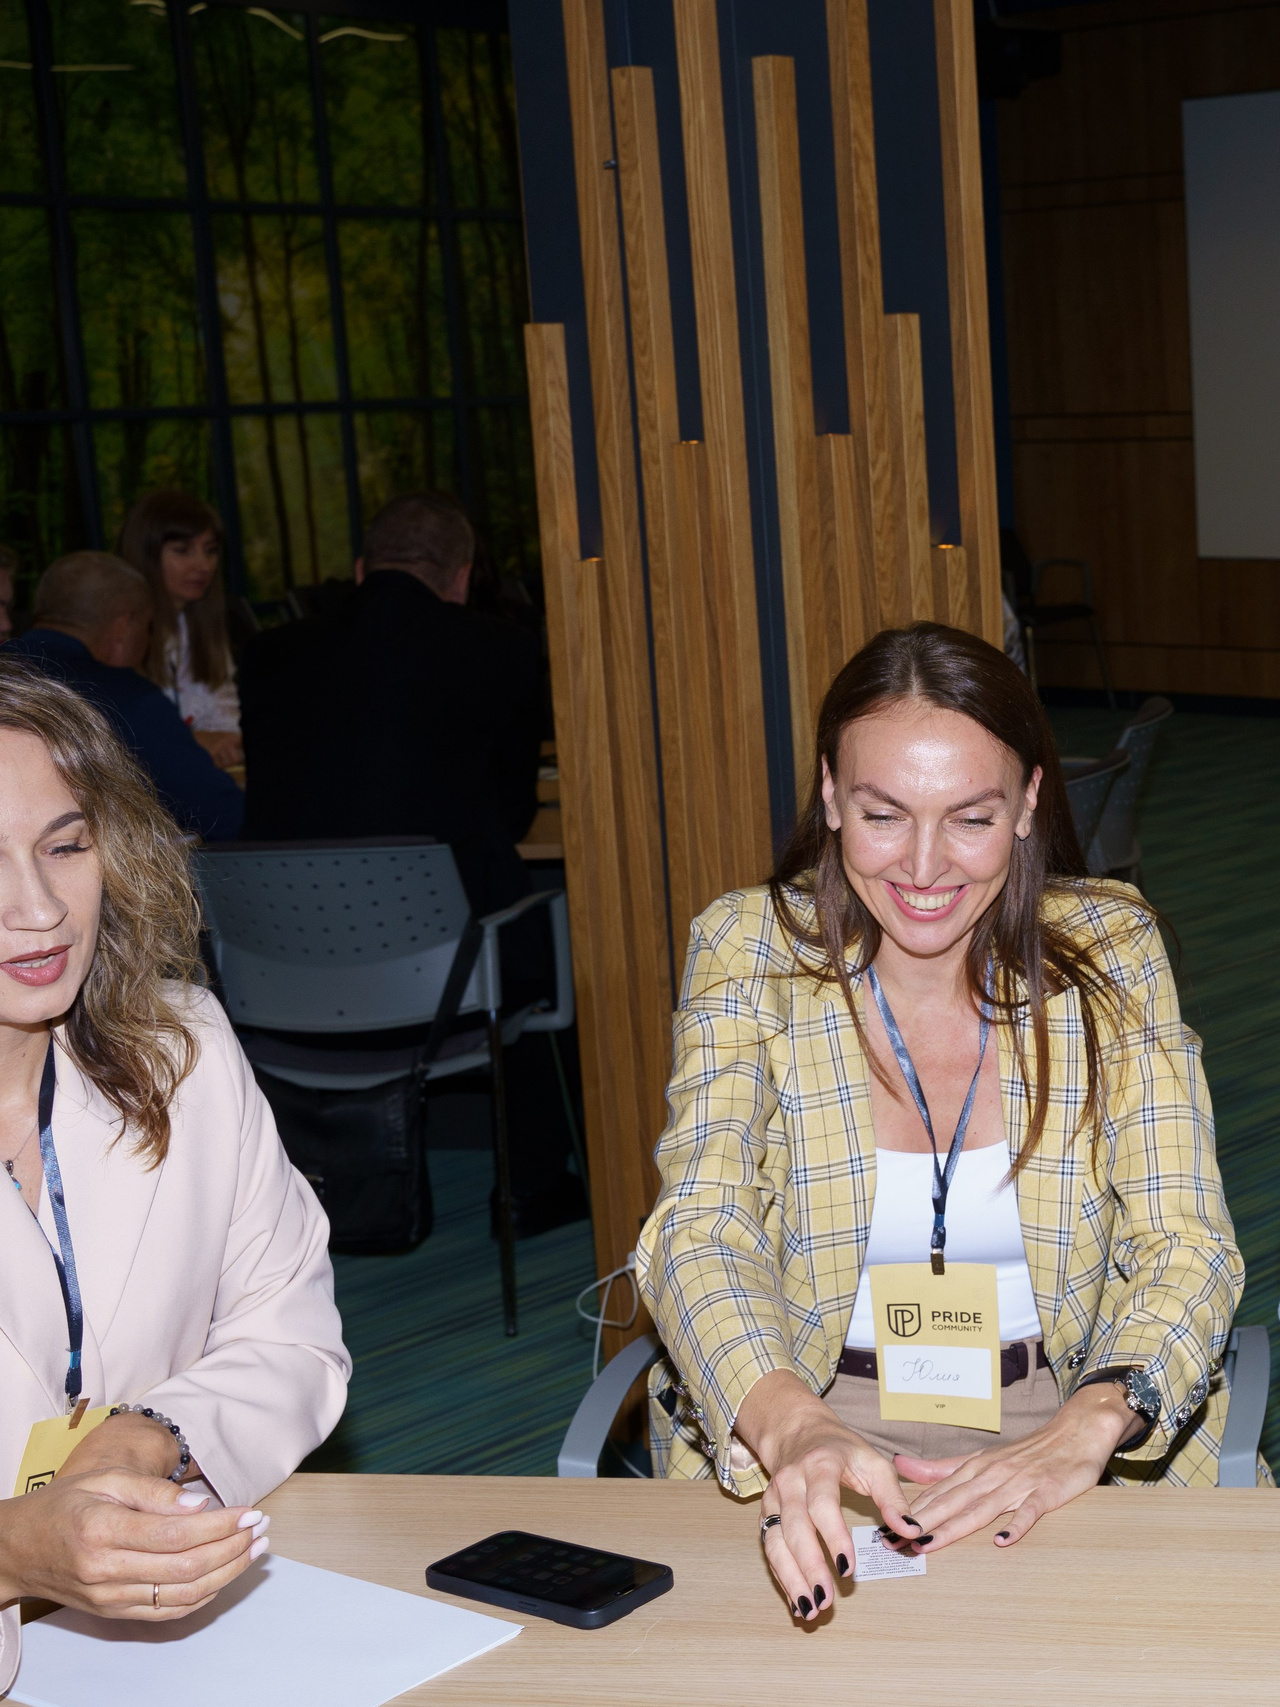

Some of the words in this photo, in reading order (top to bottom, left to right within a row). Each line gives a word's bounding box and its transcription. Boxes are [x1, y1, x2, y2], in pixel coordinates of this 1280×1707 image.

[931, 1311, 982, 1324] PRIDE
[932, 1324, 982, 1332] COMMUNITY
[902, 1357, 960, 1381] Юлия
